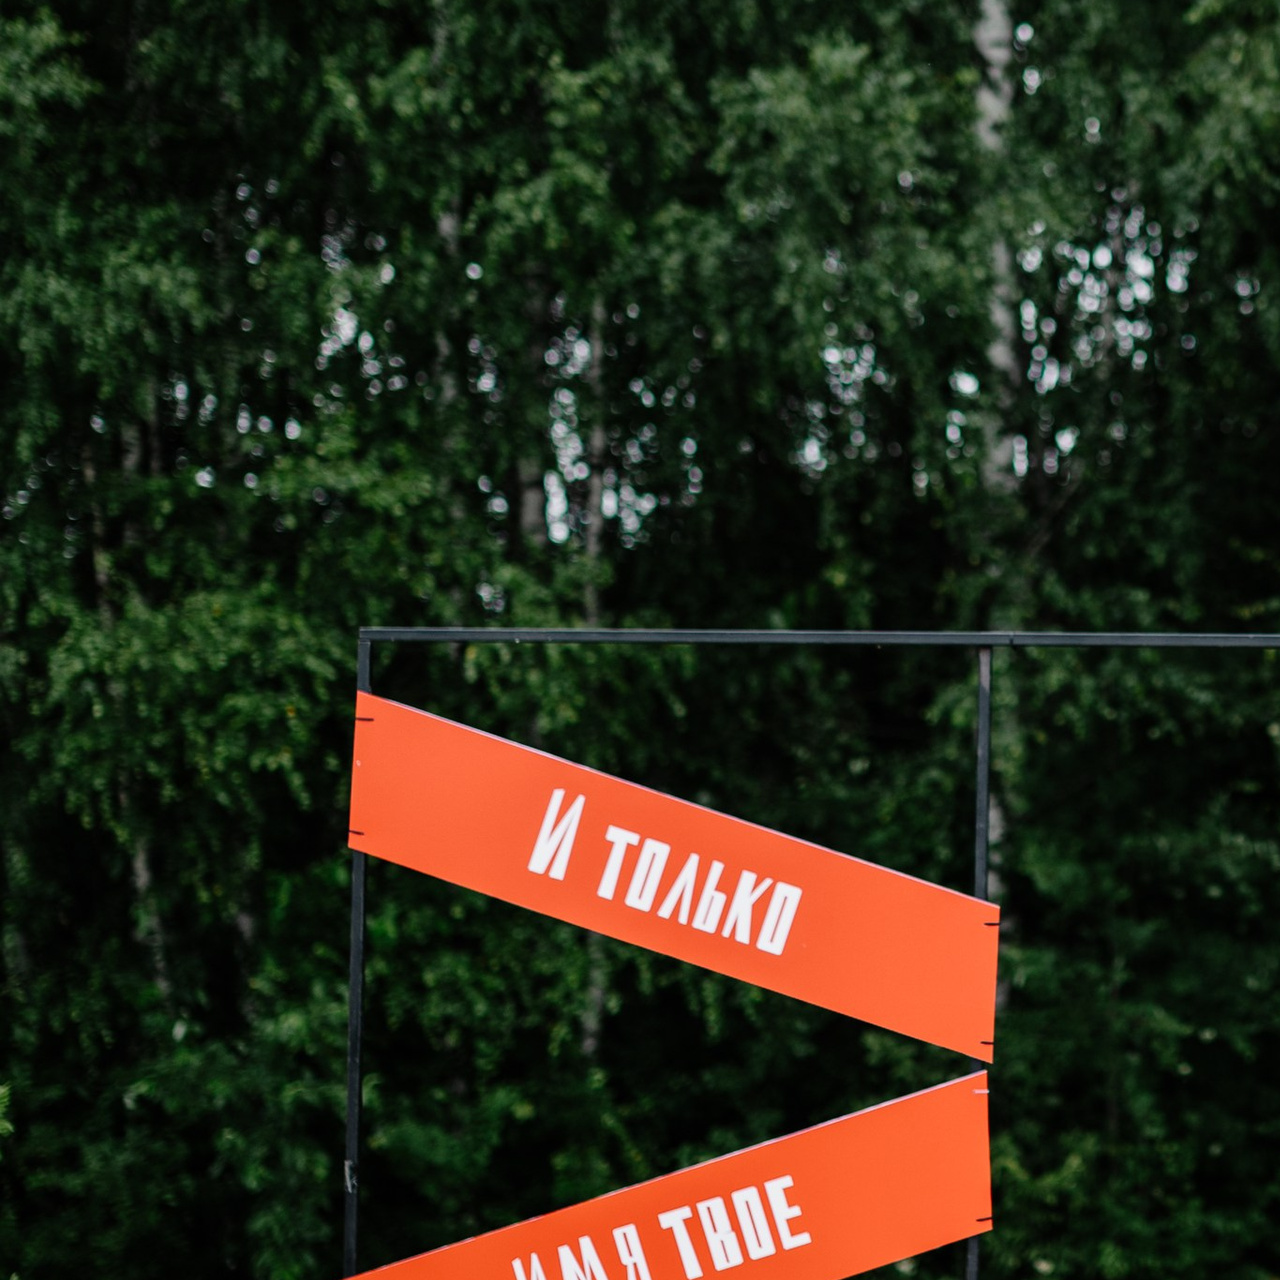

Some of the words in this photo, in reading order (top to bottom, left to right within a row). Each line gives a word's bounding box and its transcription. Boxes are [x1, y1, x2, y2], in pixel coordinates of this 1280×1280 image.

[528, 788, 586, 881] И
[597, 825, 803, 956] ТОЛЬКО
[657, 1175, 812, 1280] ТВОЕ
